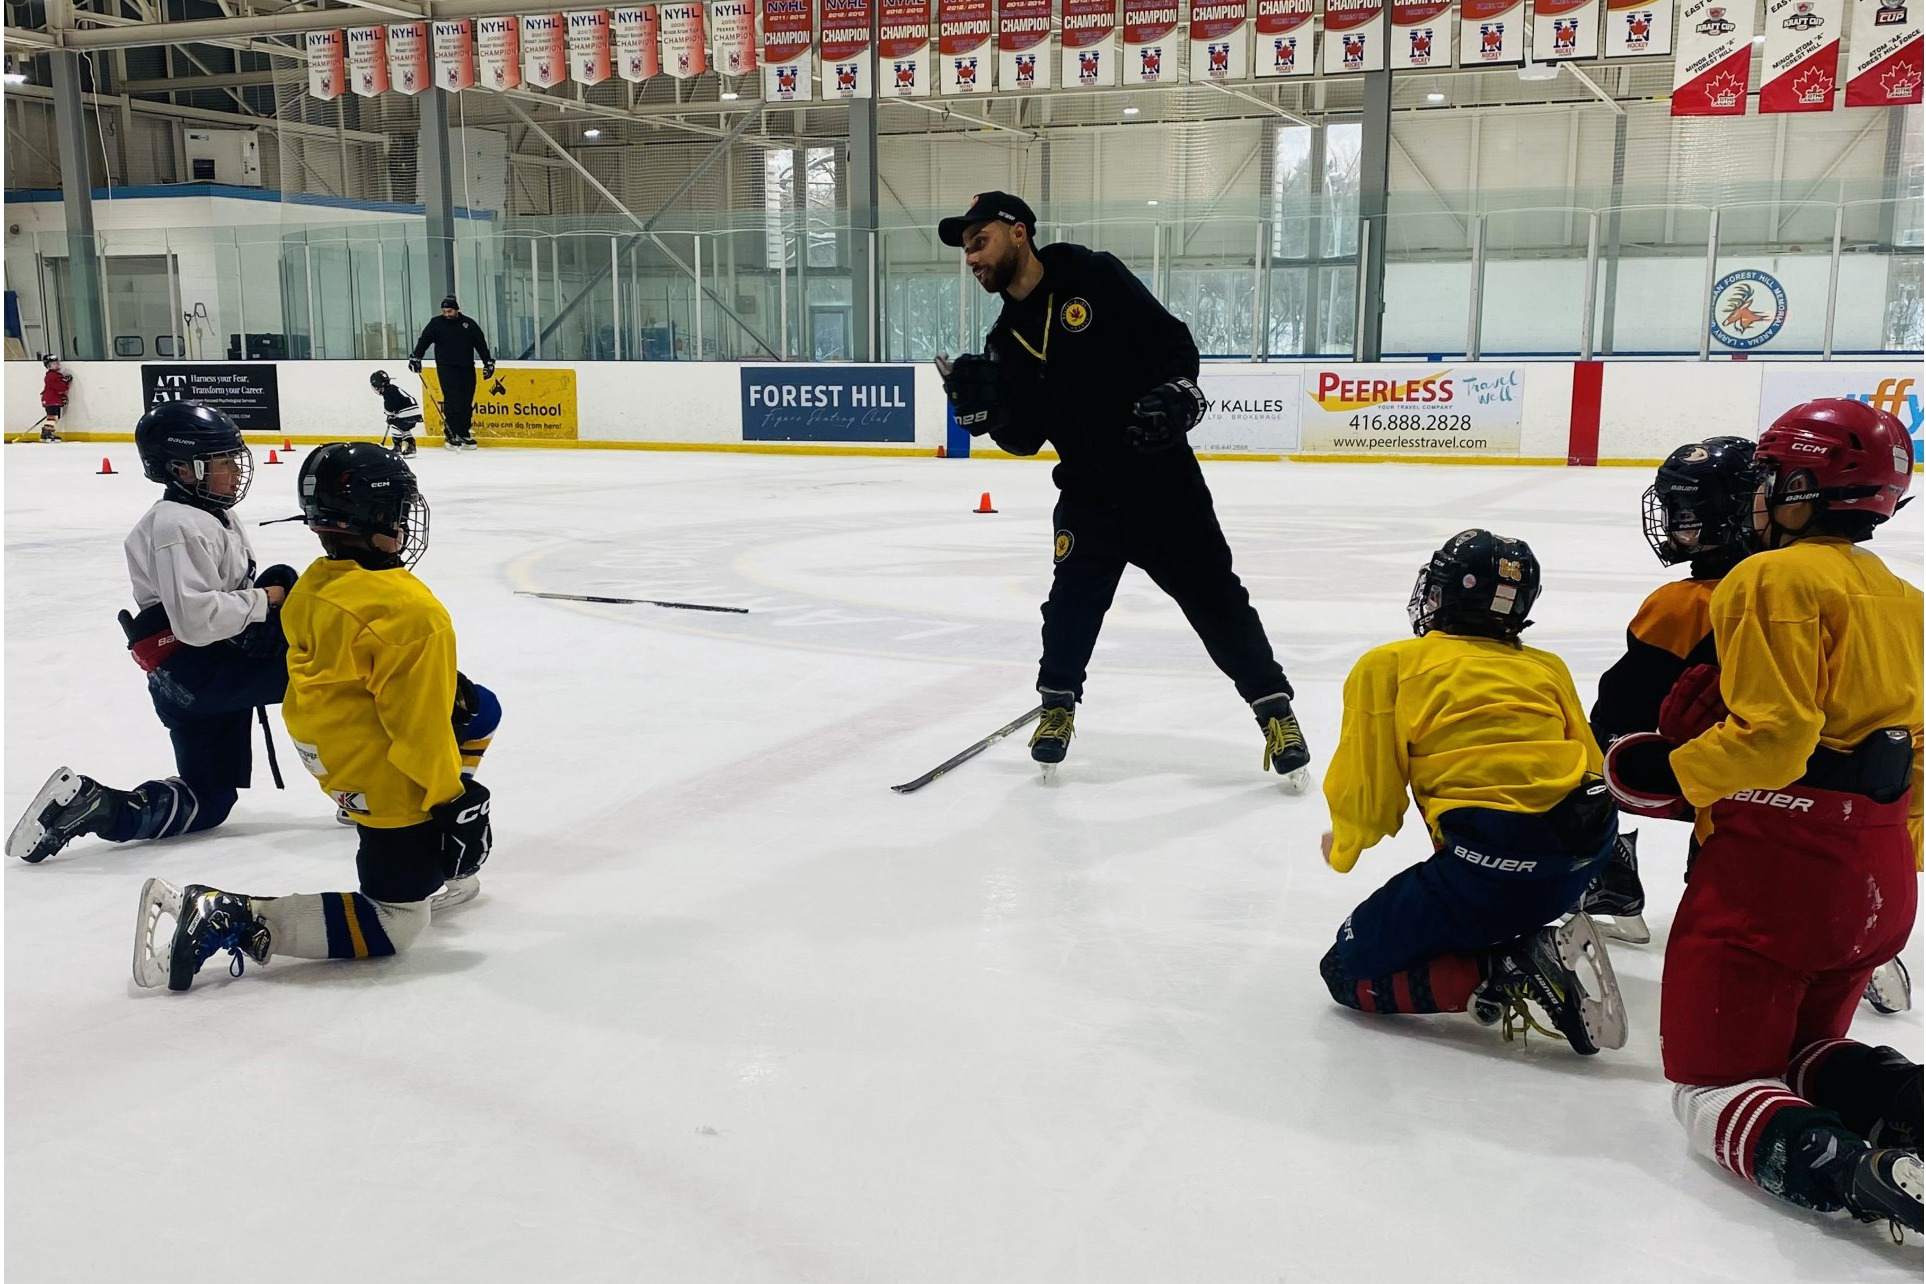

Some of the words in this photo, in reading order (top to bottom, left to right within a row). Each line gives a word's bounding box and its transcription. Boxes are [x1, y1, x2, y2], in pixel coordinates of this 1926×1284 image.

[715, 4, 751, 17] NYHL
[766, 1, 809, 13] NYHL
[1193, 4, 1245, 21] CHAMPION
[1260, 0, 1313, 15] CHAMPION
[1684, 2, 1705, 18] EAST
[618, 11, 653, 23] NYHL
[664, 8, 700, 20] NYHL
[1126, 9, 1177, 25] CHAMPION
[1879, 13, 1904, 23] CUP
[481, 21, 514, 33] NYHL
[526, 18, 559, 30] NYHL
[571, 15, 606, 27] NYHL
[1001, 17, 1050, 33] CHAMPION
[1064, 13, 1114, 29] CHAMPION
[391, 28, 423, 39] NYHL
[436, 24, 468, 36] NYHL
[881, 24, 929, 40] CHAMPION
[941, 20, 990, 36] CHAMPION
[309, 34, 339, 46] NYHL
[351, 30, 381, 42] NYHL
[663, 35, 703, 44] CHAMPION
[713, 33, 753, 42] CHAMPION
[764, 30, 810, 45] CHAMPION
[822, 27, 870, 43] CHAMPION
[525, 45, 562, 53] CHAMPION
[570, 42, 608, 51] CHAMPION
[616, 39, 655, 47] CHAMPION
[435, 50, 470, 59] CHAMPION
[480, 48, 516, 57] CHAMPION
[1772, 54, 1794, 69] MINOR
[1795, 40, 1814, 54] ATOM
[1782, 53, 1806, 70] FOREST
[1807, 42, 1821, 54] HILL
[1858, 54, 1883, 72] FOREST
[1884, 43, 1899, 56] HILL
[1900, 28, 1922, 44] FORCE
[1869, 44, 1888, 58] ATOM
[350, 56, 383, 64] CHAMPION
[390, 53, 425, 62] CHAMPION
[1685, 56, 1707, 73] MINOR
[1708, 45, 1725, 59] ATOM
[1694, 57, 1718, 74] FOREST
[1719, 48, 1733, 60] HILL
[308, 60, 341, 69] CHAMPION
[1725, 272, 1757, 285] FOREST
[1759, 275, 1774, 288] HILL
[1773, 287, 1785, 327] MEMORIAL
[190, 374, 216, 383] Harness
[217, 376, 232, 384] your
[1462, 370, 1520, 397] Travel
[191, 386, 225, 395] Transform
[225, 387, 240, 396] your
[1318, 372, 1454, 403] PEERLESS
[749, 385, 843, 407] FOREST
[851, 385, 906, 407] HILL
[513, 402, 561, 416] School
[1222, 400, 1283, 412] KALLES
[487, 422, 499, 430] you
[1349, 414, 1472, 431] 416.888.2828
[1333, 436, 1488, 450] www.peerlesstravel.com
[1791, 442, 1829, 454] CCM
[1419, 613, 1435, 625] CCM
